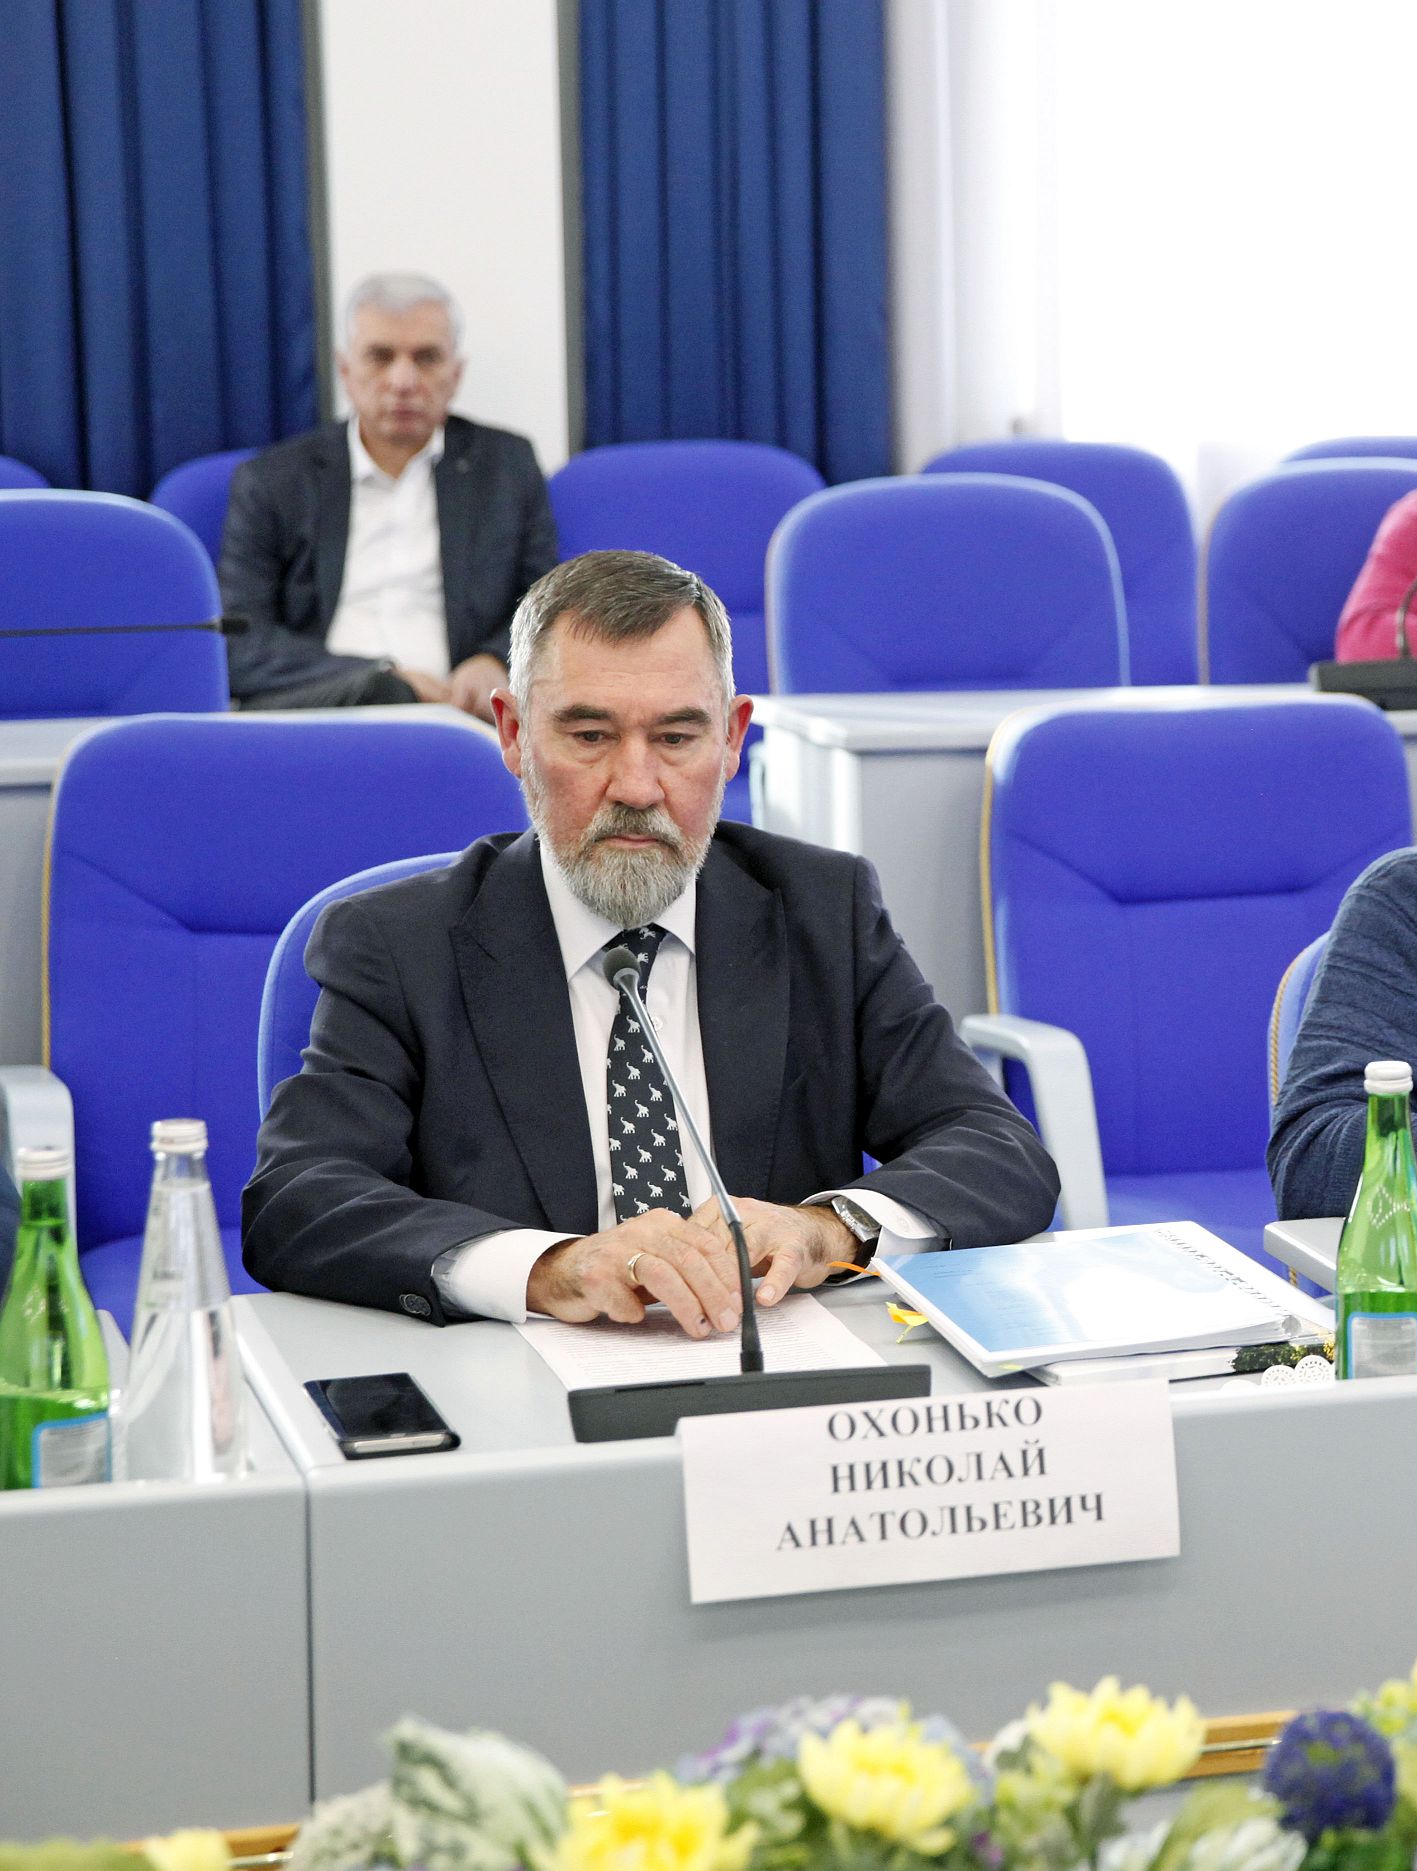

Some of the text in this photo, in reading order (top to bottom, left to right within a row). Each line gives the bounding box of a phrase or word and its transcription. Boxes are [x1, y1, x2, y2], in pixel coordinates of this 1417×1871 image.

[828, 1396, 1043, 1441] ОХОНЬКО
[830, 1439, 1047, 1494] НИКОЛАЙ
[776, 1492, 1105, 1550] АНАТОЛЬЕВИЧ
